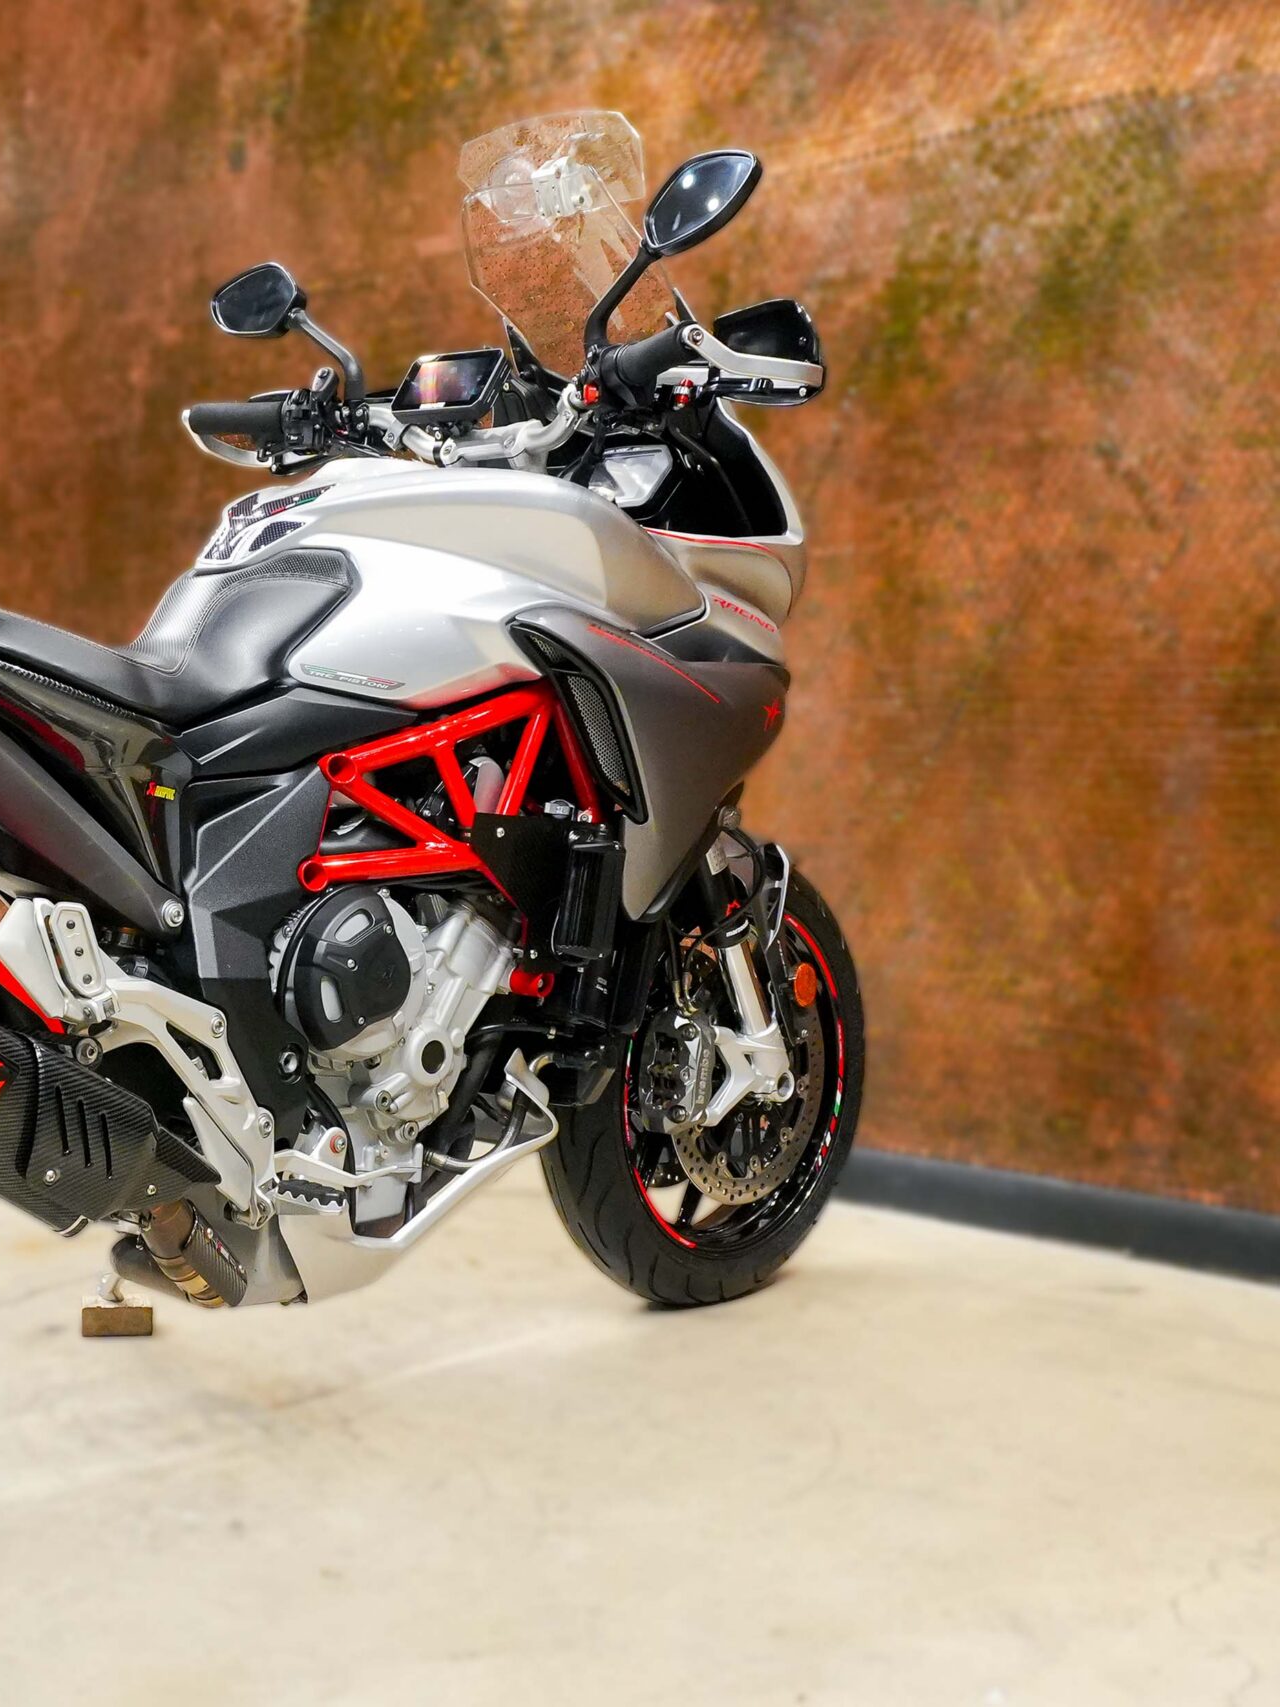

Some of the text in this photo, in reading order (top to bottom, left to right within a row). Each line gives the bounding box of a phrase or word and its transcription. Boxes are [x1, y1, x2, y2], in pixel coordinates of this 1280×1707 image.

[711, 593, 776, 632] RACING
[309, 670, 389, 690] TRE PISTONI
[695, 1048, 710, 1105] brembo
